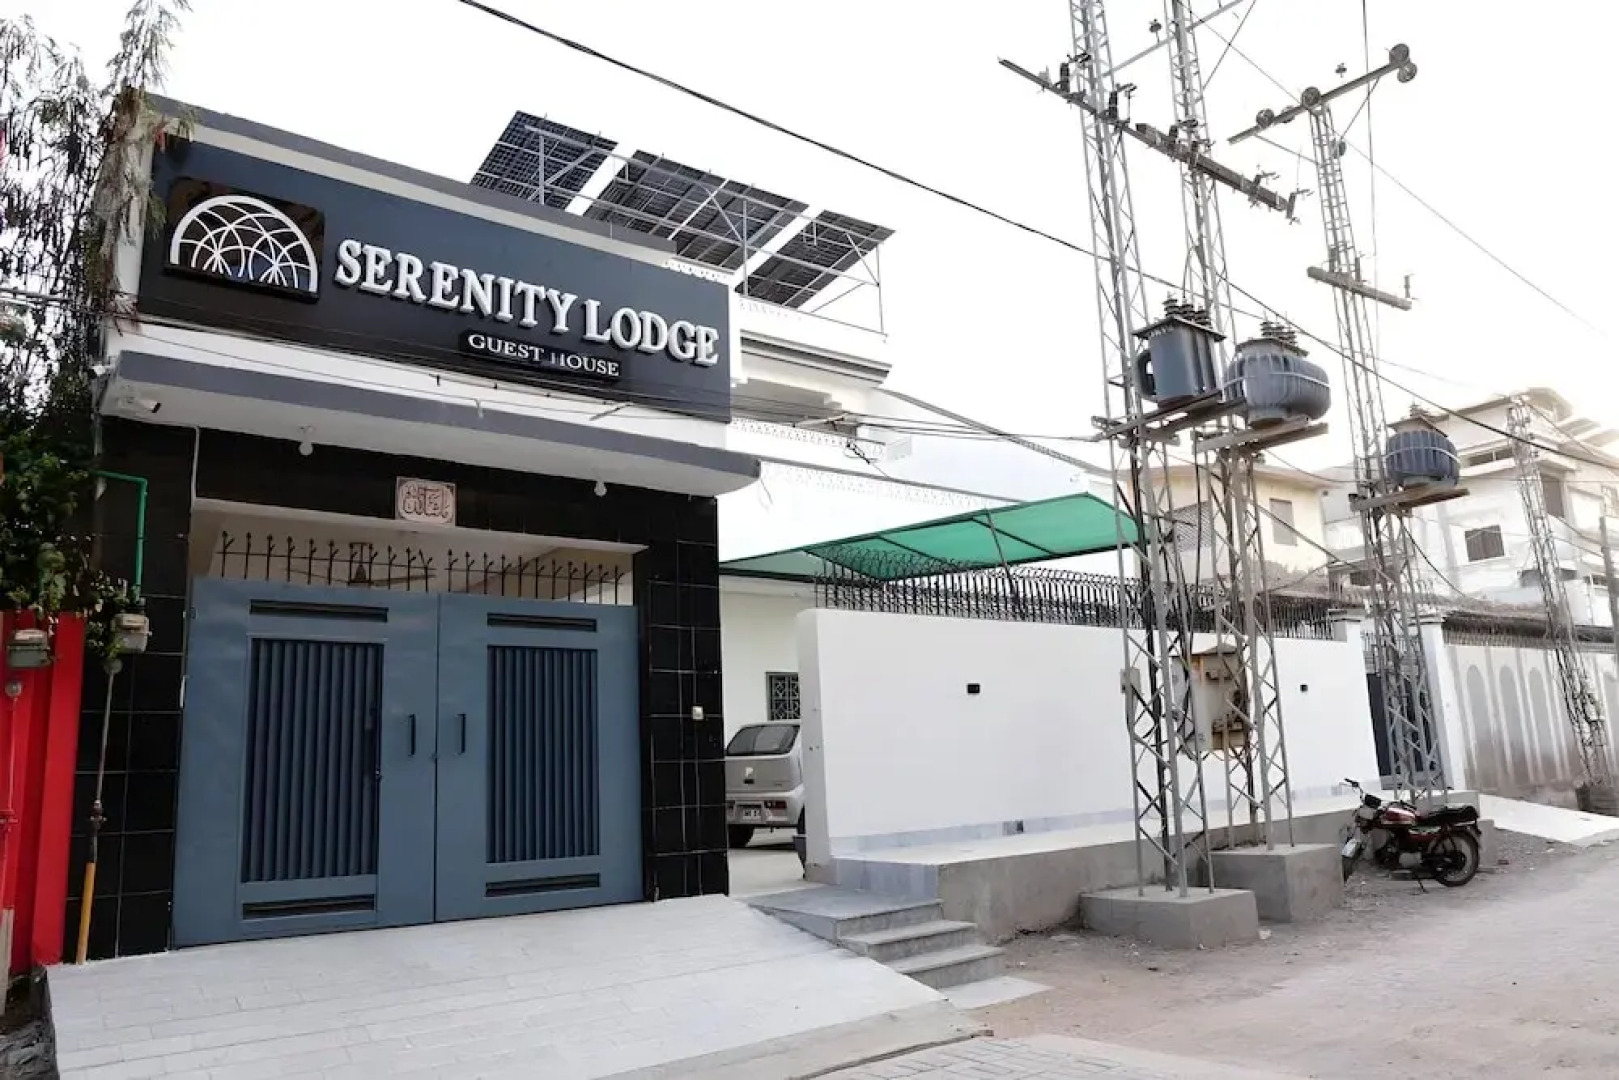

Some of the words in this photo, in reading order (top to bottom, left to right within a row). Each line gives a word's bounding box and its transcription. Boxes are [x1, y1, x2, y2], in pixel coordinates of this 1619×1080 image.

[334, 238, 579, 333] SERENITY
[582, 298, 720, 366] LODGE
[467, 334, 545, 362] GUEST
